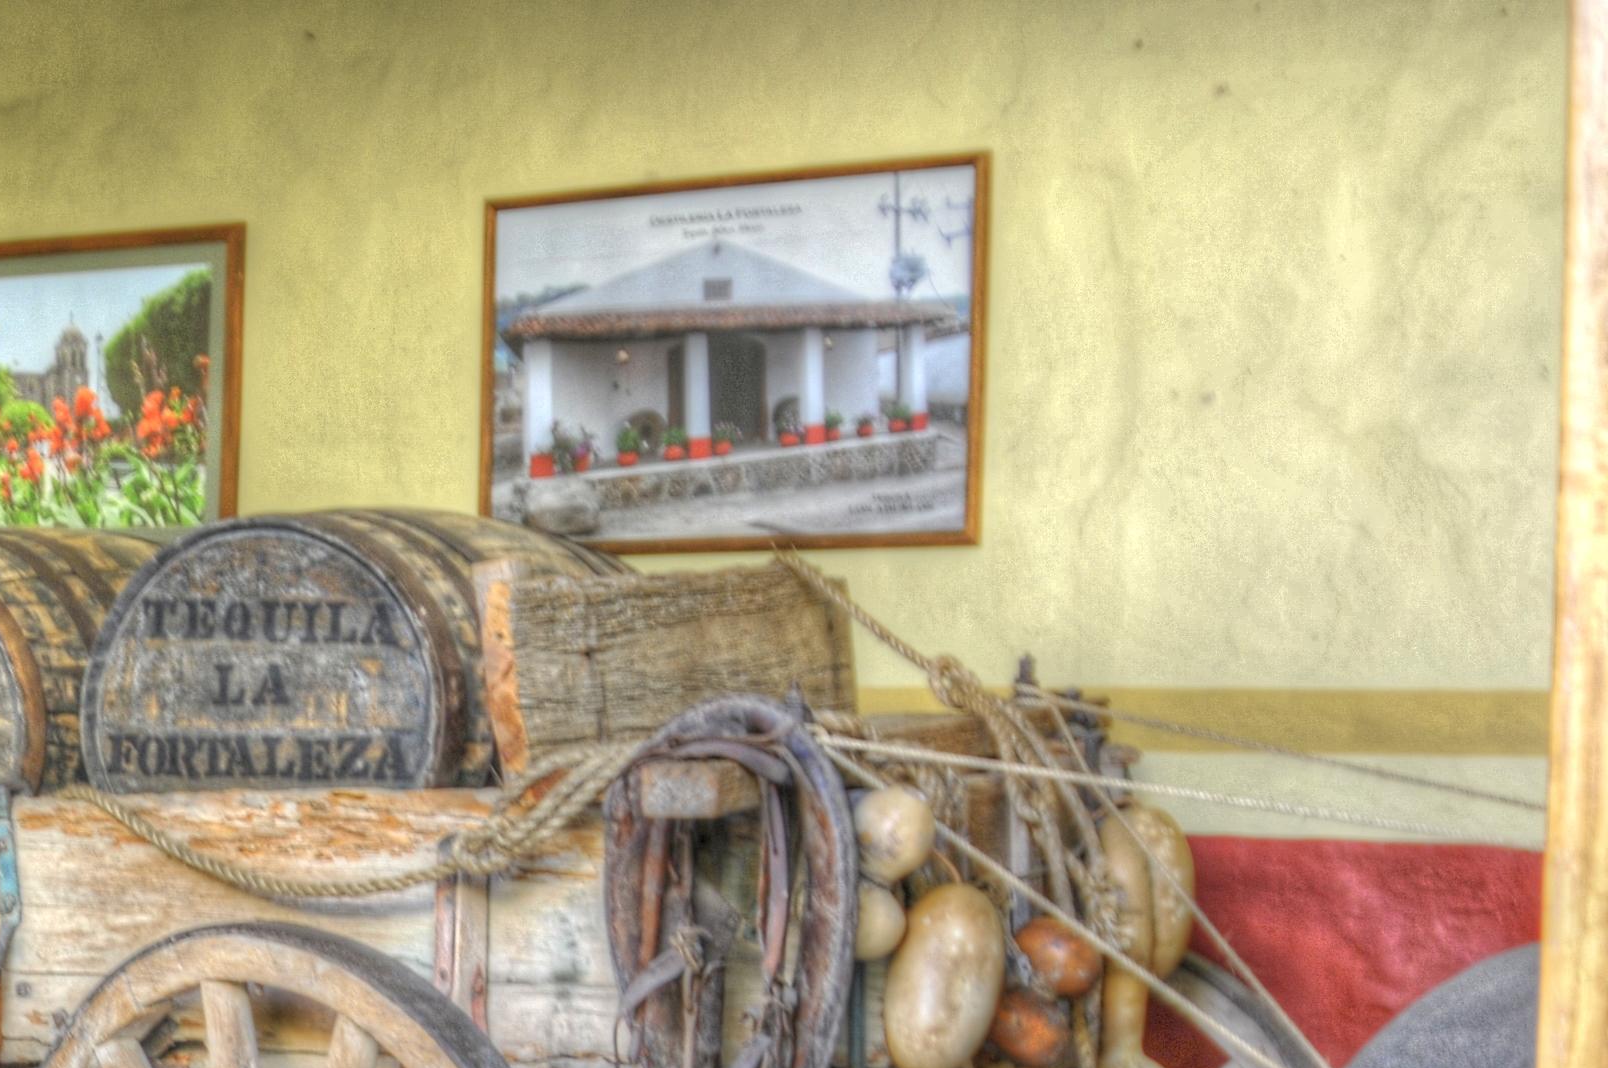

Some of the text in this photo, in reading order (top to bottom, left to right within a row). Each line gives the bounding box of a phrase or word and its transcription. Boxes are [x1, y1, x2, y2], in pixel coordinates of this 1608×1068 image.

[143, 600, 403, 647] TEQUILA
[211, 663, 290, 706] LA
[108, 731, 414, 781] FORTALEZA
